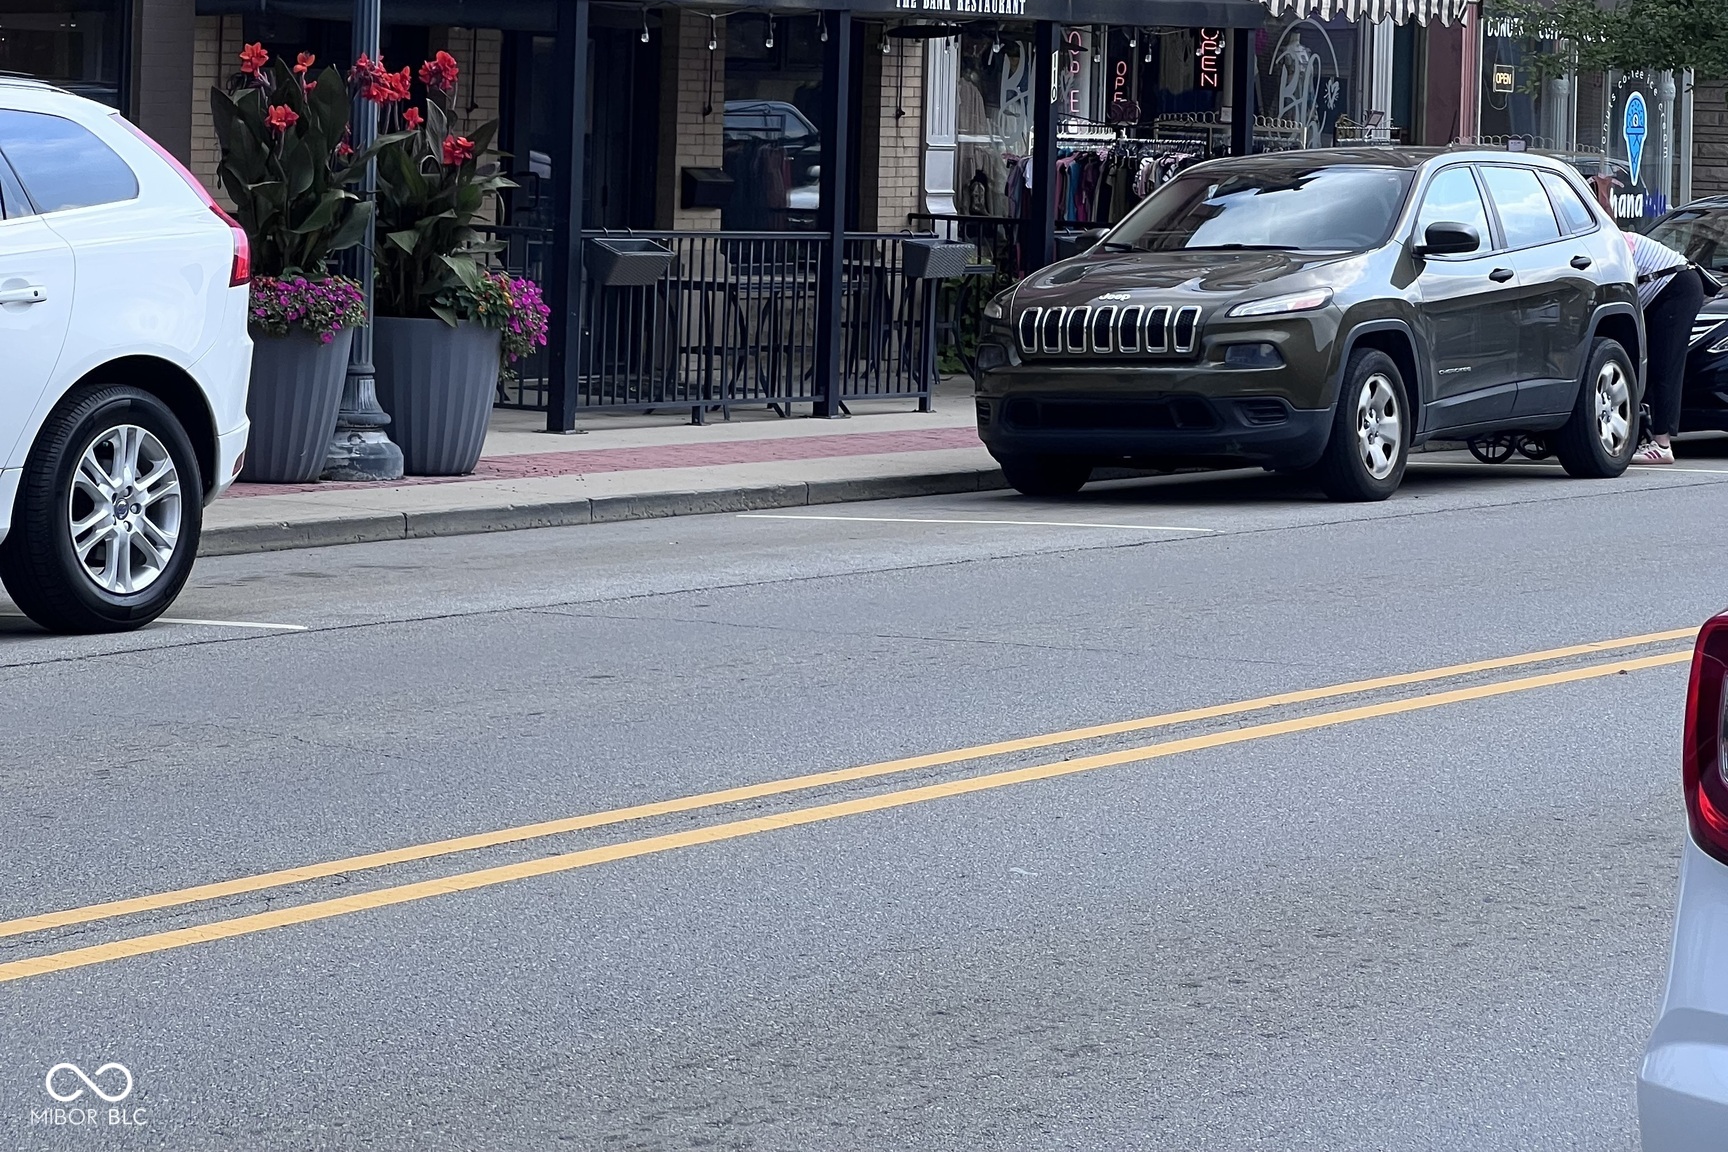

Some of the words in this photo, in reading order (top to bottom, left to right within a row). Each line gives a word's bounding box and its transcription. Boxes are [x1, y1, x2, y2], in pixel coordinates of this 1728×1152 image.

[1068, 30, 1082, 113] OPE
[1201, 27, 1219, 88] OPEN
[1495, 71, 1512, 85] OPEN
[1112, 60, 1127, 103] OPE
[1098, 292, 1131, 302] Jeep
